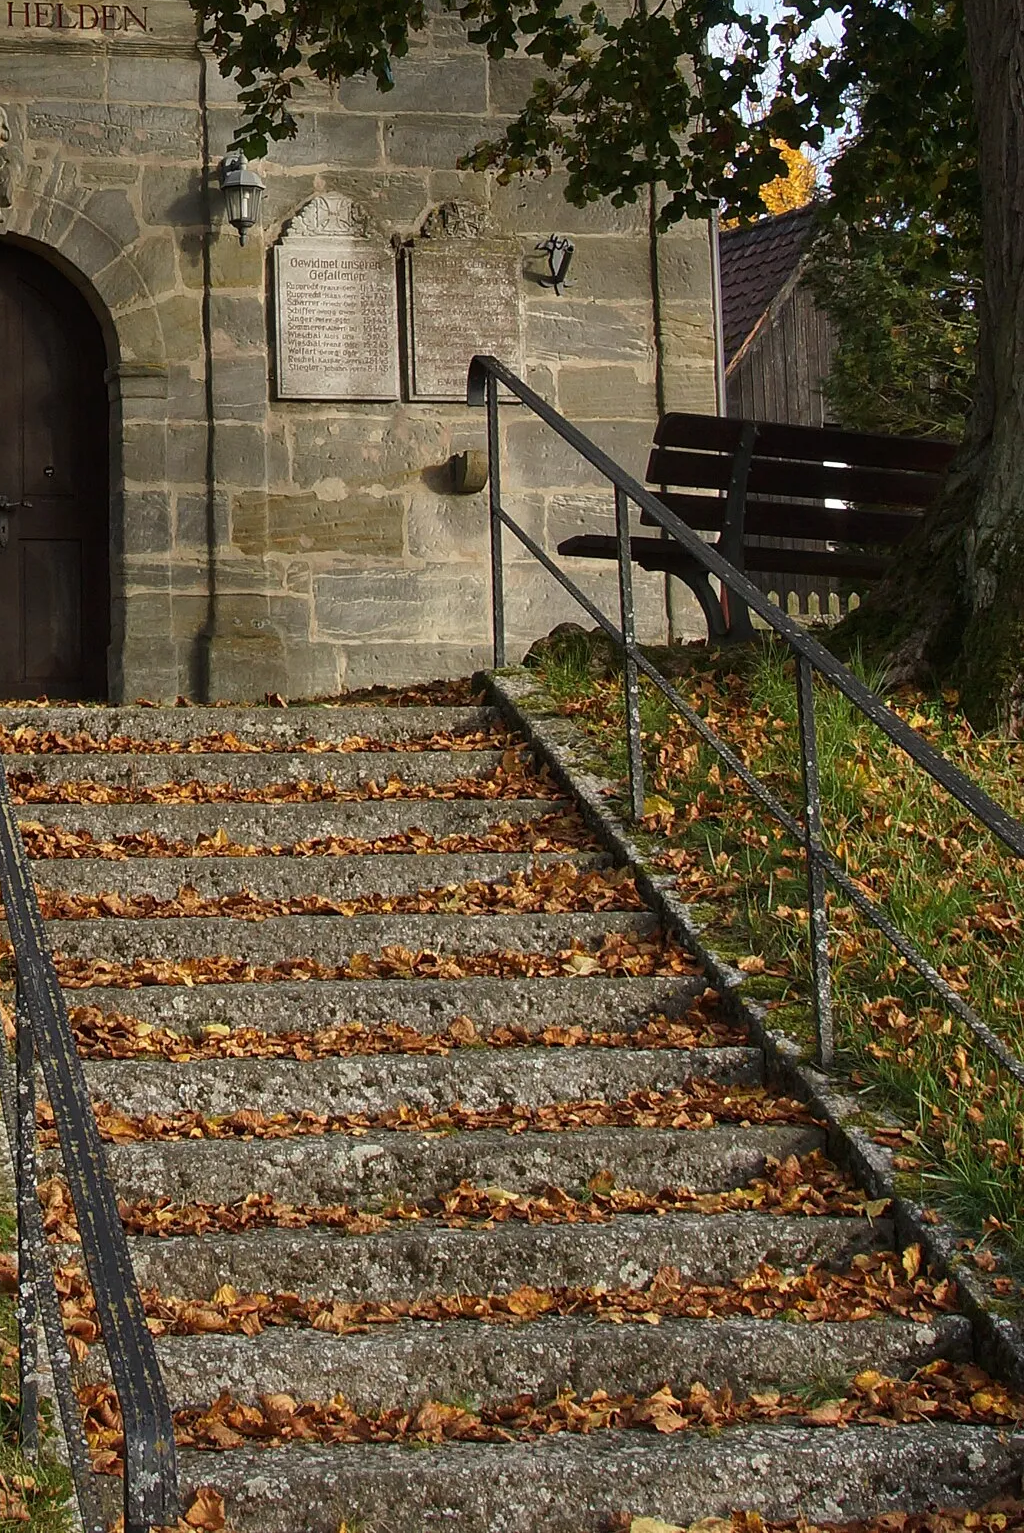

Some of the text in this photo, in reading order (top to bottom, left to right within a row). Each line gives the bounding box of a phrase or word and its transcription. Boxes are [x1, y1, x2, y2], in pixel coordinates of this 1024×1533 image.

[290, 257, 382, 271] Gewidmet unseren
[309, 269, 365, 282] Gefallenen
[287, 314, 312, 325] Singer
